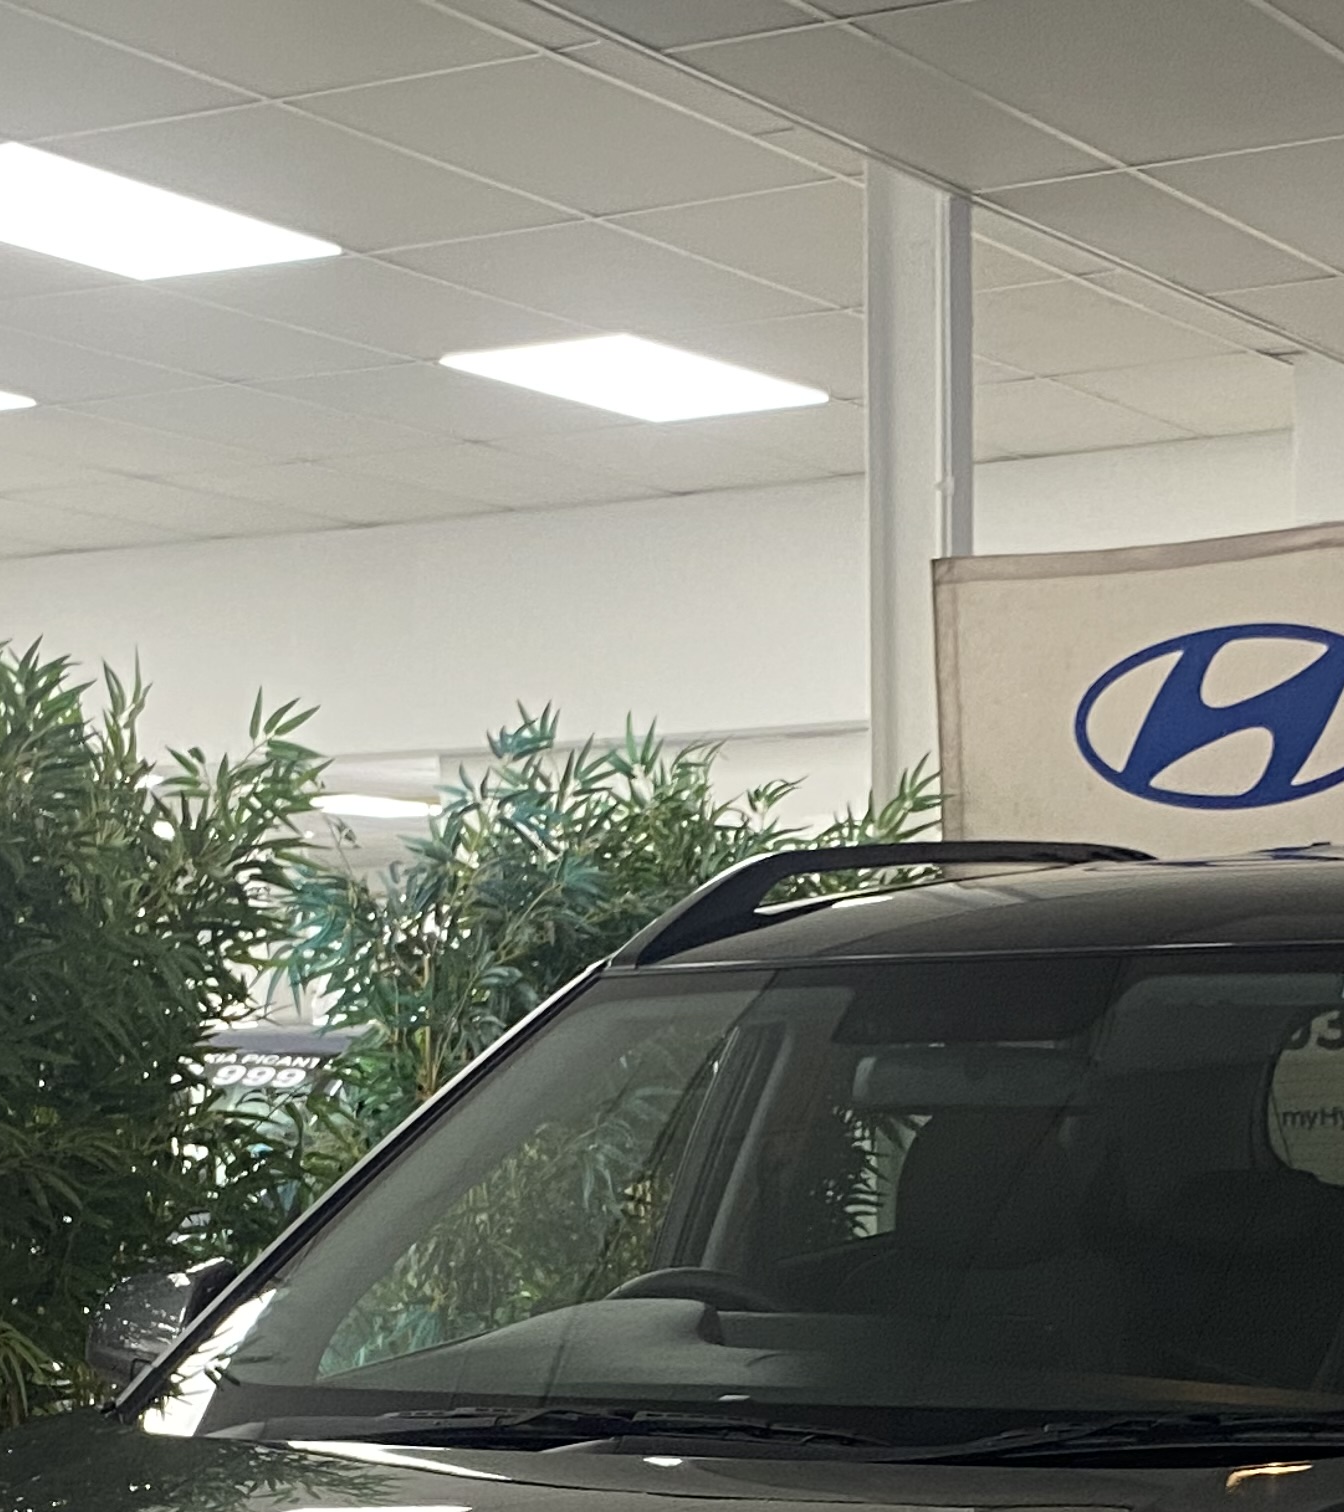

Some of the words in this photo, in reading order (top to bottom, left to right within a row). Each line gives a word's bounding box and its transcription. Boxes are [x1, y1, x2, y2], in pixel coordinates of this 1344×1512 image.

[204, 1053, 237, 1064] KIA
[241, 1053, 321, 1069] PICANT
[212, 1064, 307, 1088] 999
